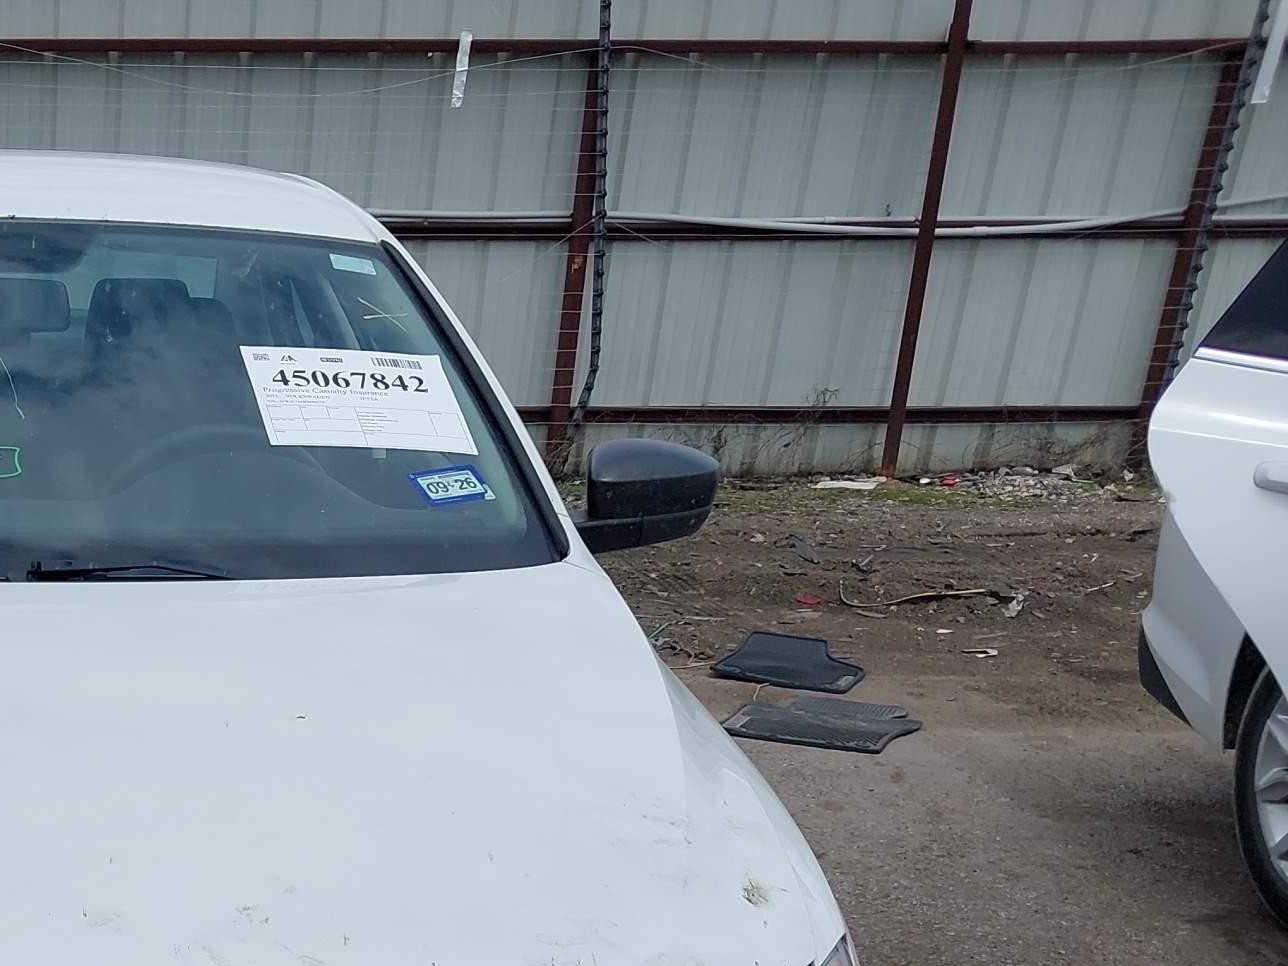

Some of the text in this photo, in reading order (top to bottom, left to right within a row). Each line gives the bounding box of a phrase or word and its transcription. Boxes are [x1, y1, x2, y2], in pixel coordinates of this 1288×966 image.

[272, 368, 429, 393] 45067842
[263, 386, 311, 394] Progressive
[312, 388, 347, 396] Casualty
[426, 477, 478, 495] 09 26
